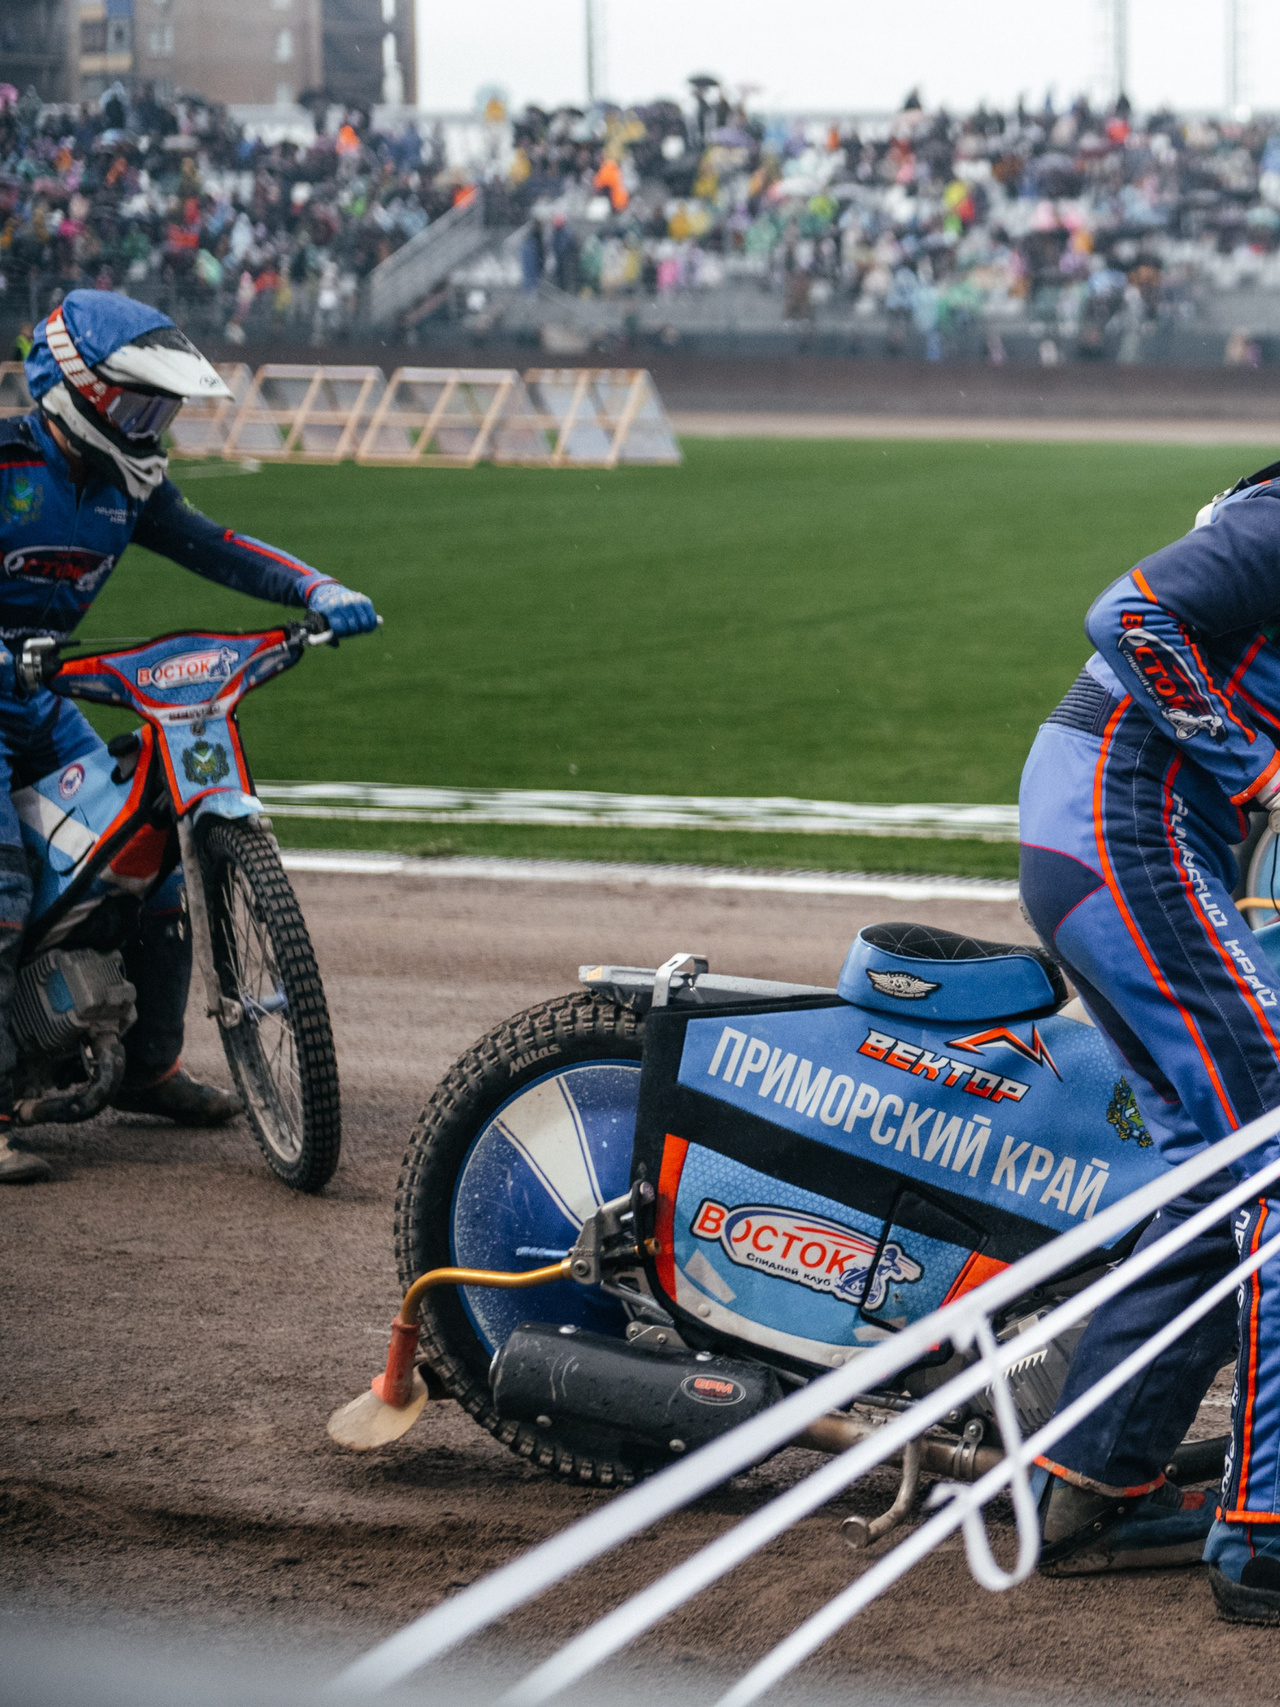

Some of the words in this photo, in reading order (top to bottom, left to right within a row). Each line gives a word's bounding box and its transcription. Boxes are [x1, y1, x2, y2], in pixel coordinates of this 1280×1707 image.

[138, 658, 212, 684] ВОСТОК
[509, 1043, 561, 1077] Mitas
[858, 1028, 1032, 1103] ВЕКТОР
[707, 1026, 992, 1178] ПРИМОРСКИЙ
[991, 1135, 1110, 1221] КРАЙ
[697, 1204, 857, 1275] ВОСТОК
